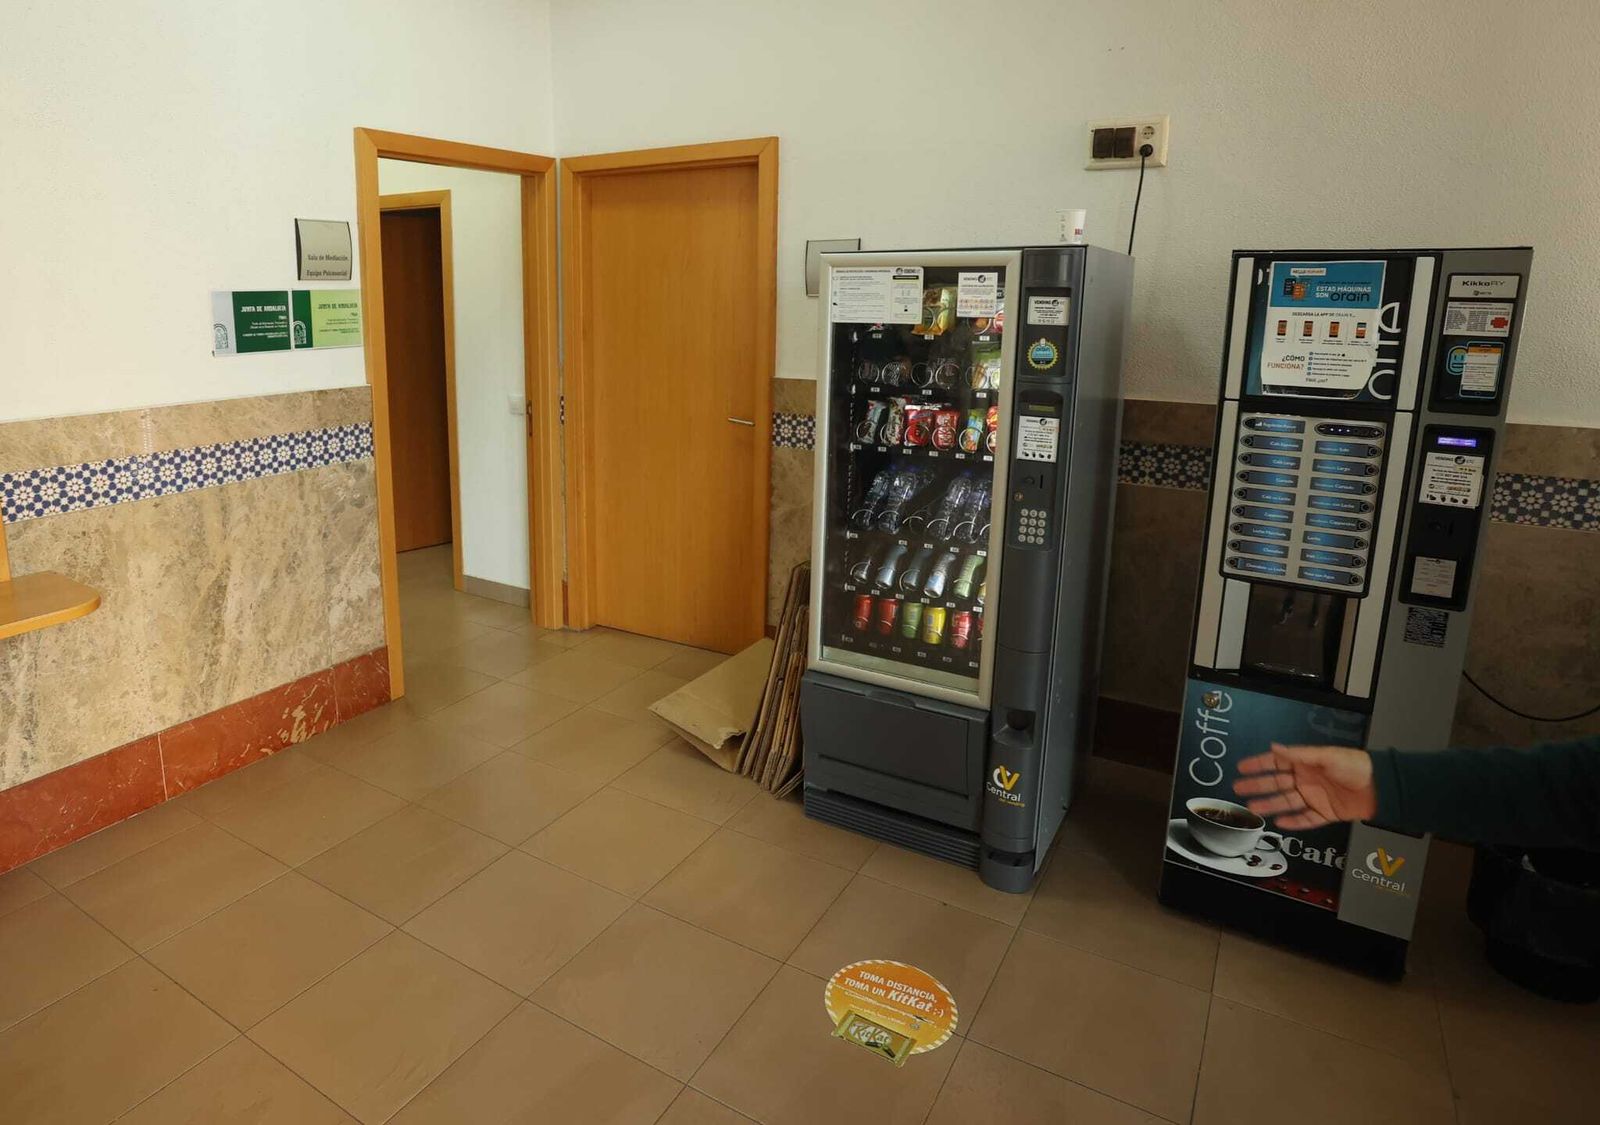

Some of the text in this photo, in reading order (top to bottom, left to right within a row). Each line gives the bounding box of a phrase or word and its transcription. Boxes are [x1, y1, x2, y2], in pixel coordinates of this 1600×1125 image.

[1330, 292, 1370, 302] orain
[986, 781, 1021, 802] Central
[1351, 868, 1406, 892] Central
[859, 970, 885, 985] TOMA
[844, 978, 870, 992] TOMA
[871, 987, 887, 997] UN
[887, 989, 934, 1013] KitKat
